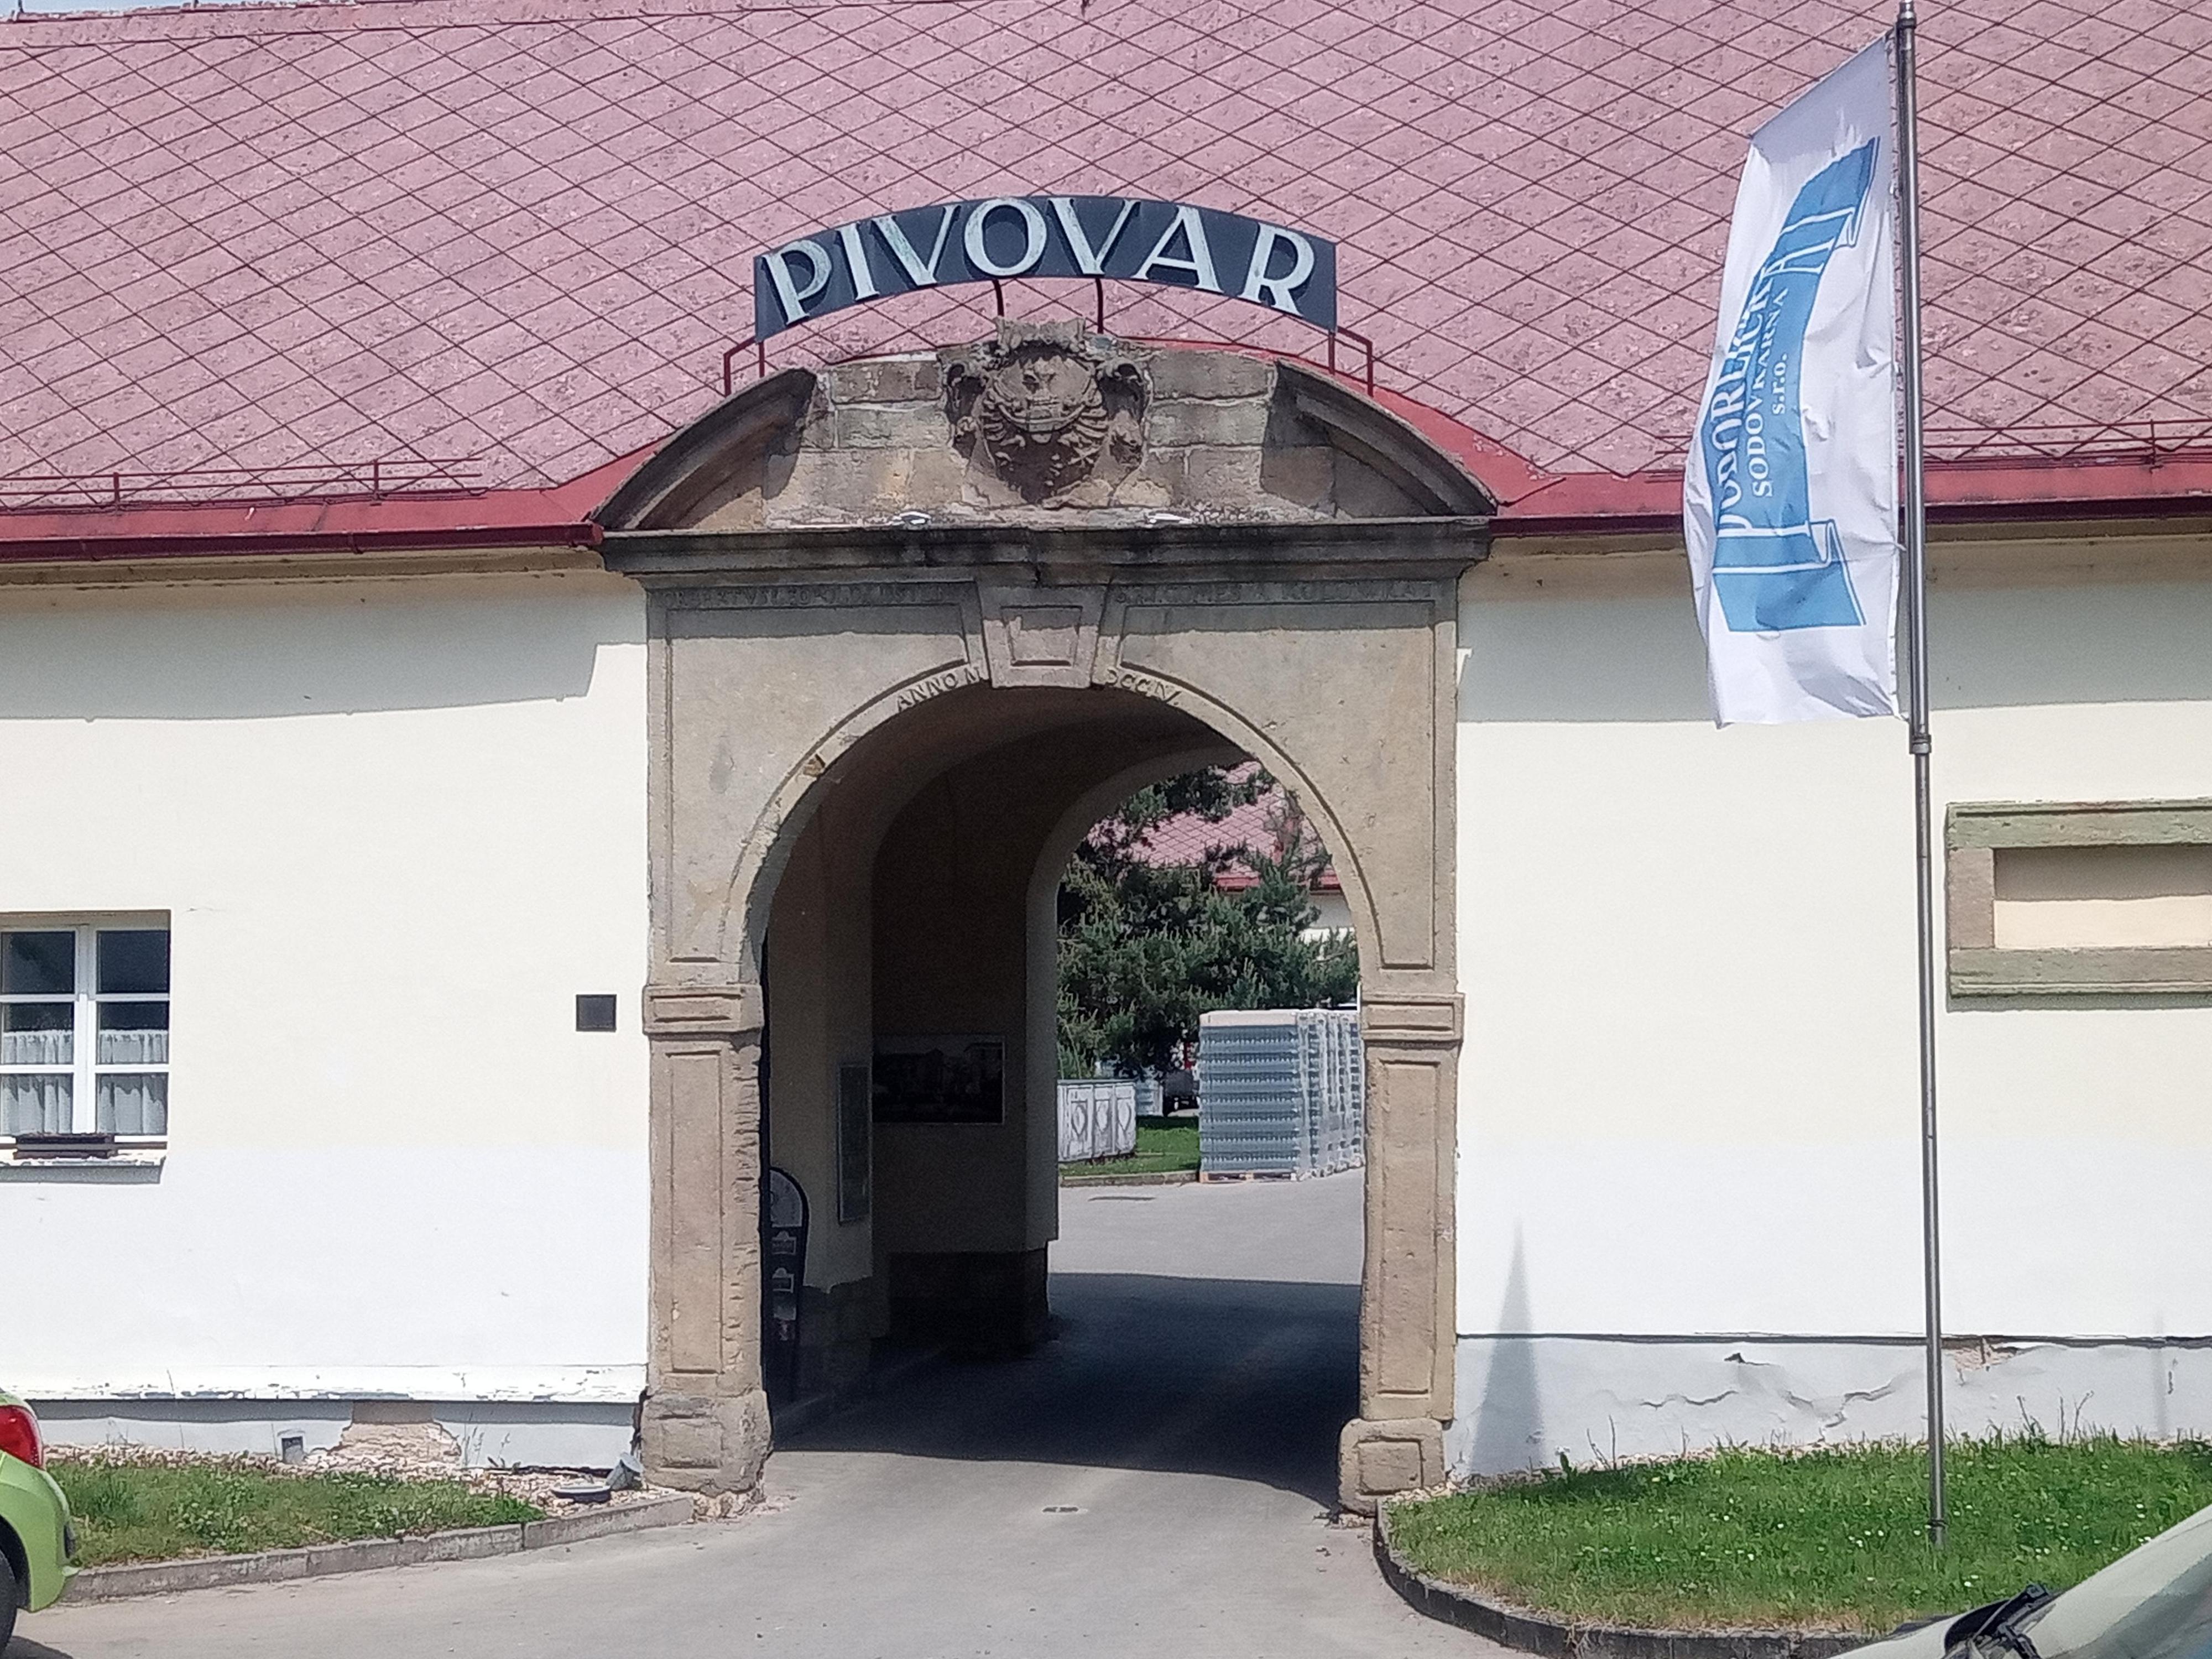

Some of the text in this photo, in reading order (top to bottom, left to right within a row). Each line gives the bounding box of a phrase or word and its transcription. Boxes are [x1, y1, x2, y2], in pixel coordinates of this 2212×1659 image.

[763, 197, 1314, 325] PIVOVAR
[1772, 353, 1787, 415] s.r.o.
[896, 673, 958, 712] ANNO
